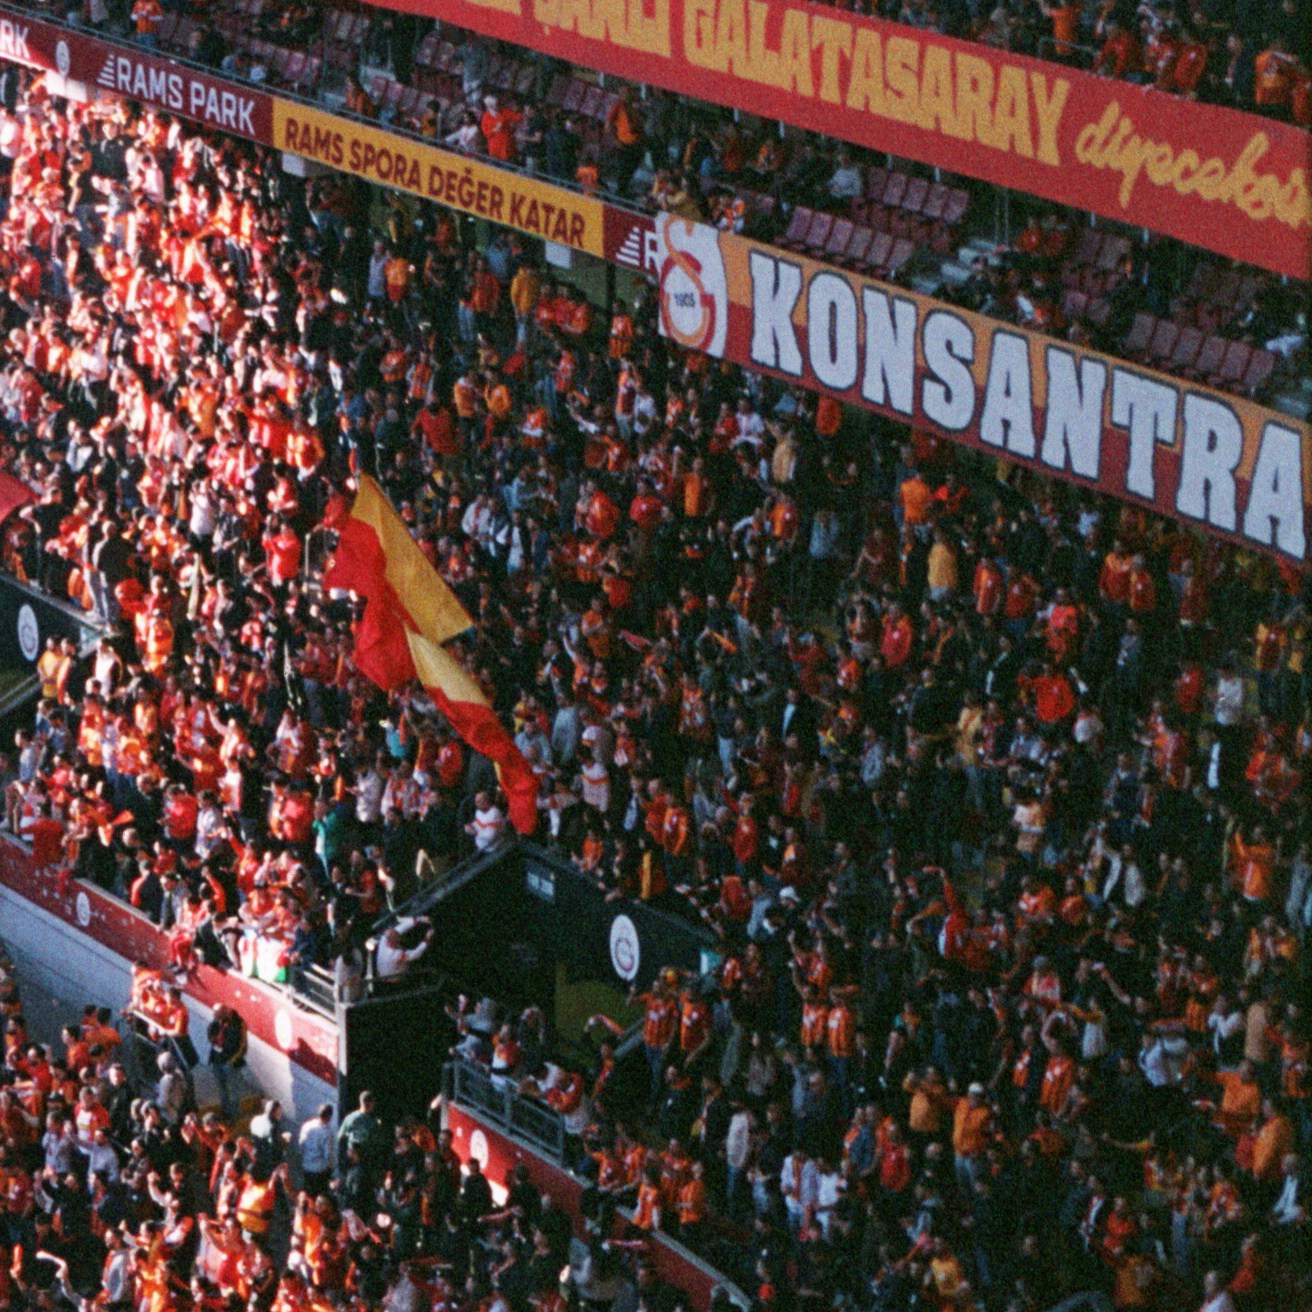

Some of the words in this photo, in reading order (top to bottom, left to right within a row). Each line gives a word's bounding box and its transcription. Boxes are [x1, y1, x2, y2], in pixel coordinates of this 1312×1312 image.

[116, 56, 184, 110] RAMS
[189, 81, 256, 136] PARK
[284, 117, 344, 166] RAMS
[348, 137, 422, 193] SPORA
[427, 164, 504, 221] DEĞER
[508, 189, 586, 248] KATAR
[748, 250, 1307, 562] KONSANTRA
